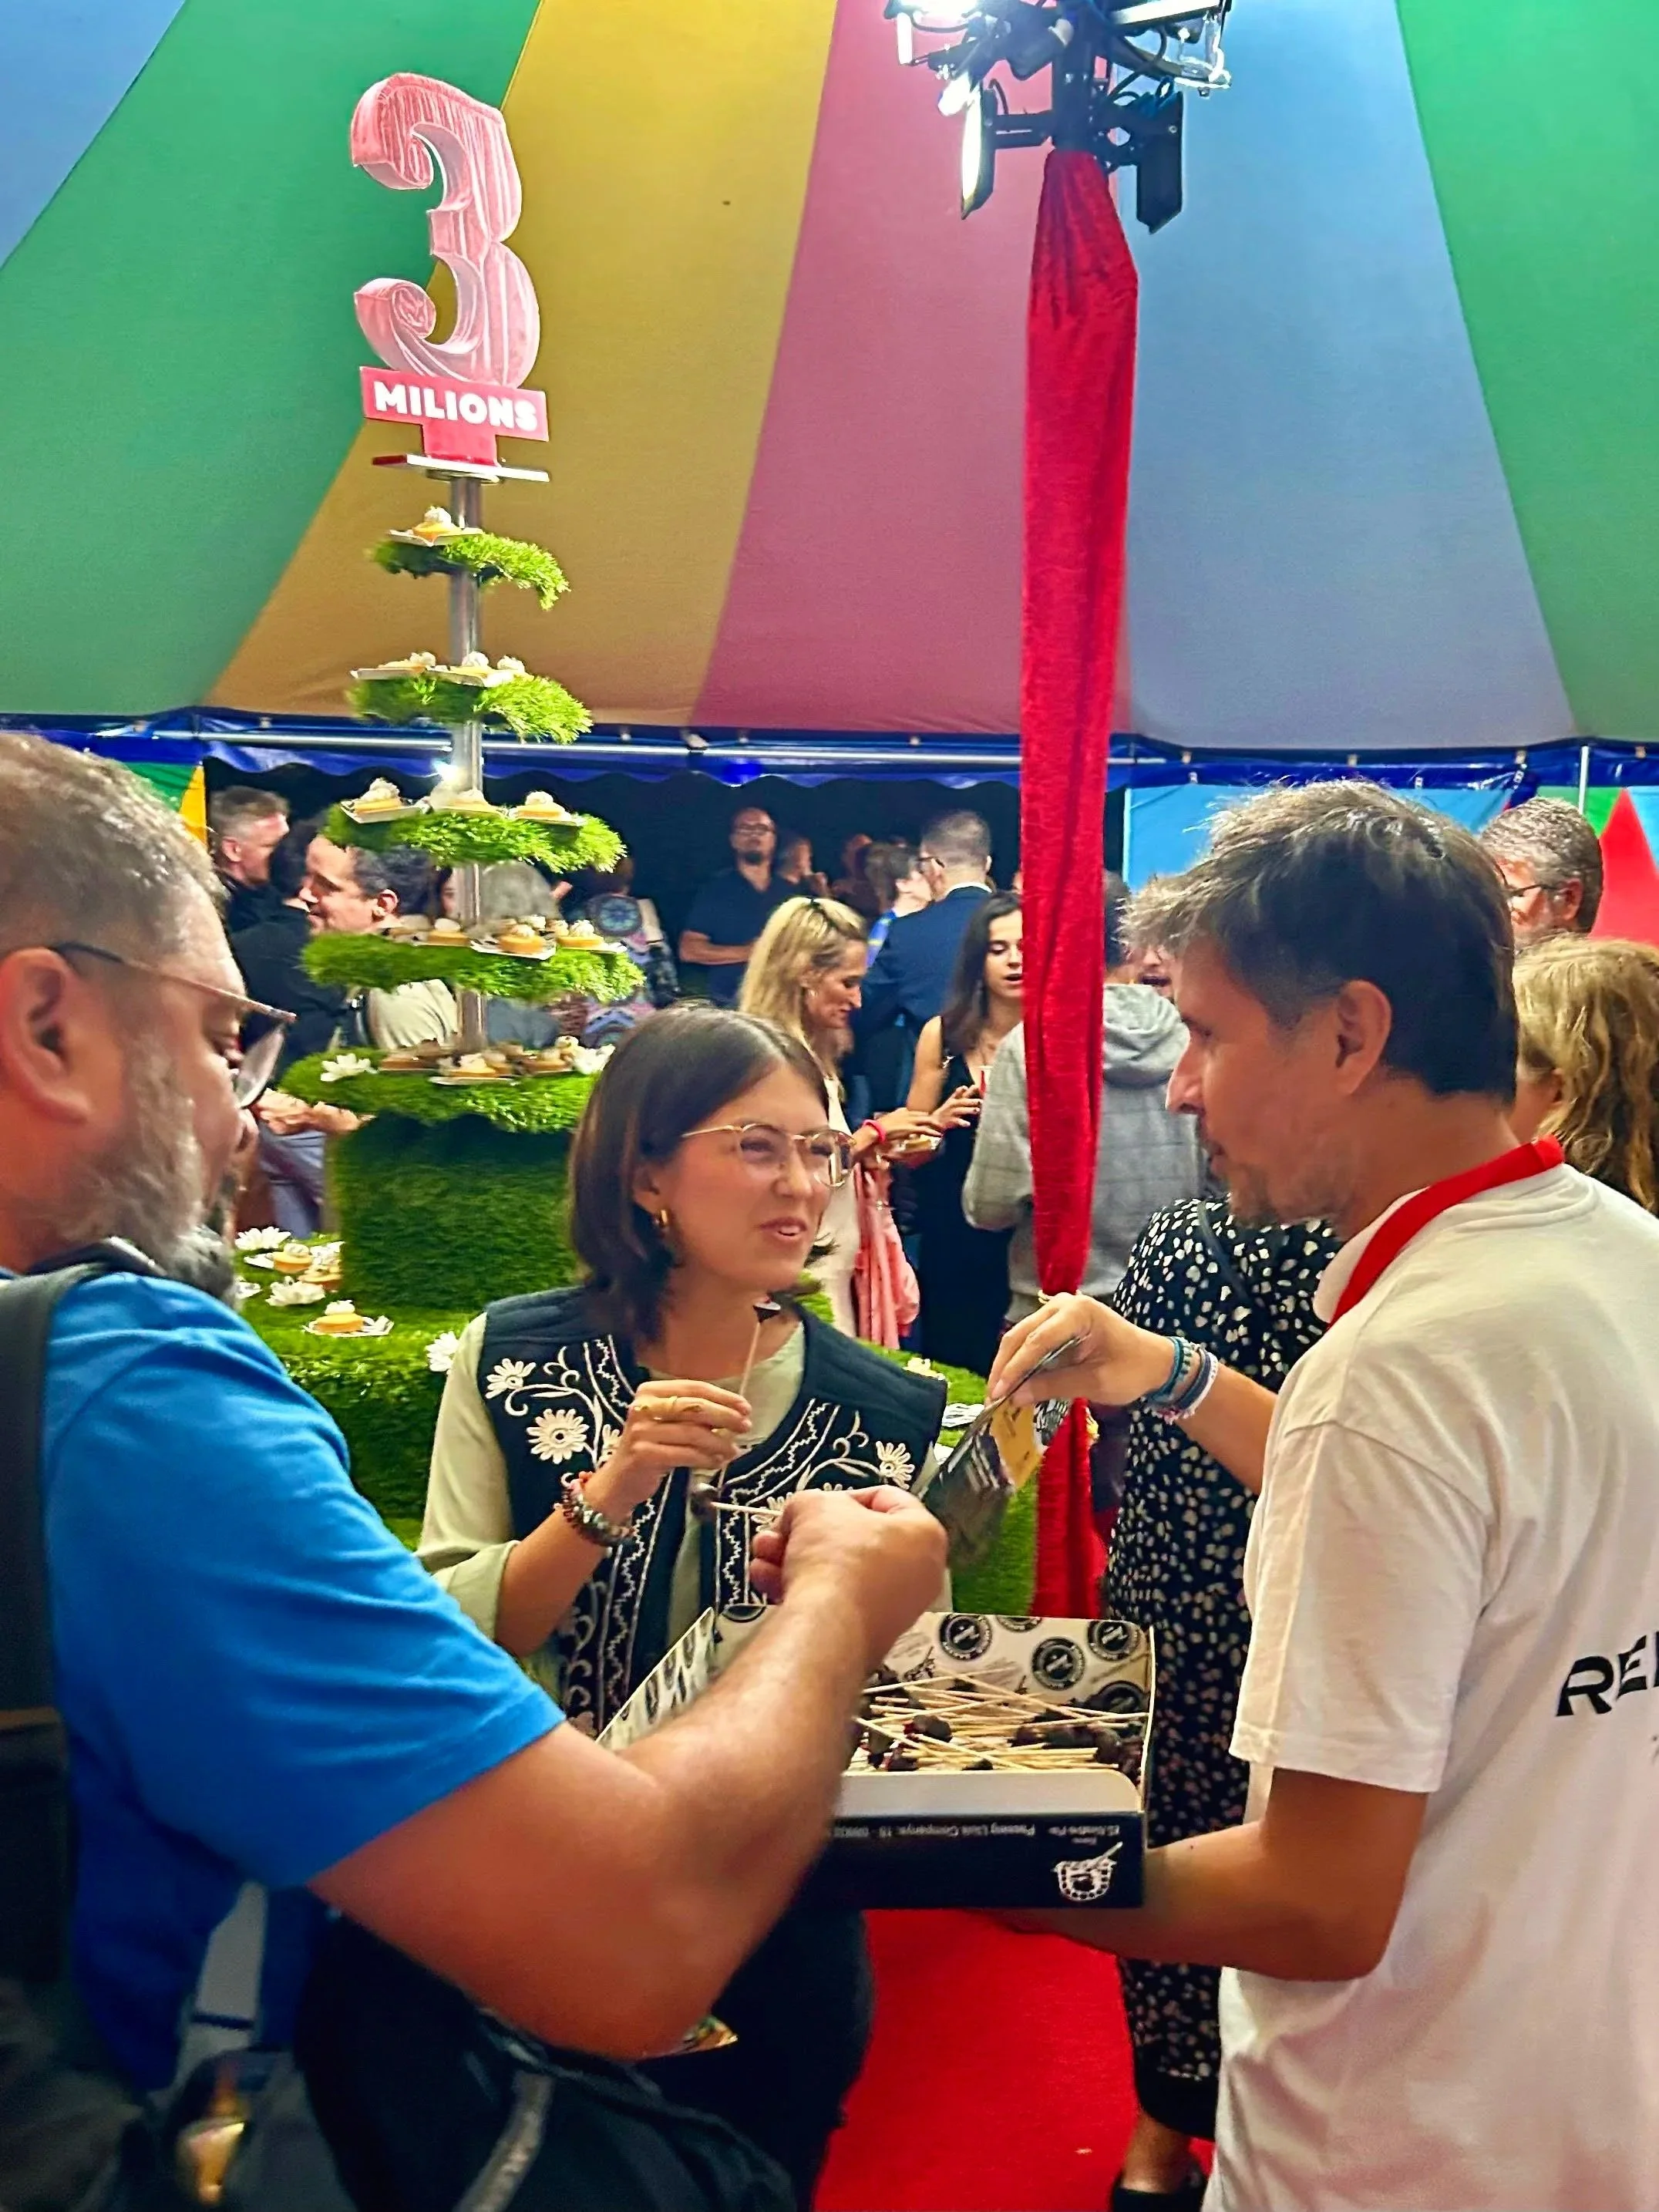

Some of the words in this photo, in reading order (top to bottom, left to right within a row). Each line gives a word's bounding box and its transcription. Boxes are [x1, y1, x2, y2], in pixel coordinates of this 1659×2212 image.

[351, 72, 540, 389] 3
[373, 381, 538, 432] MILIONS
[1556, 1631, 1659, 1716] RE
